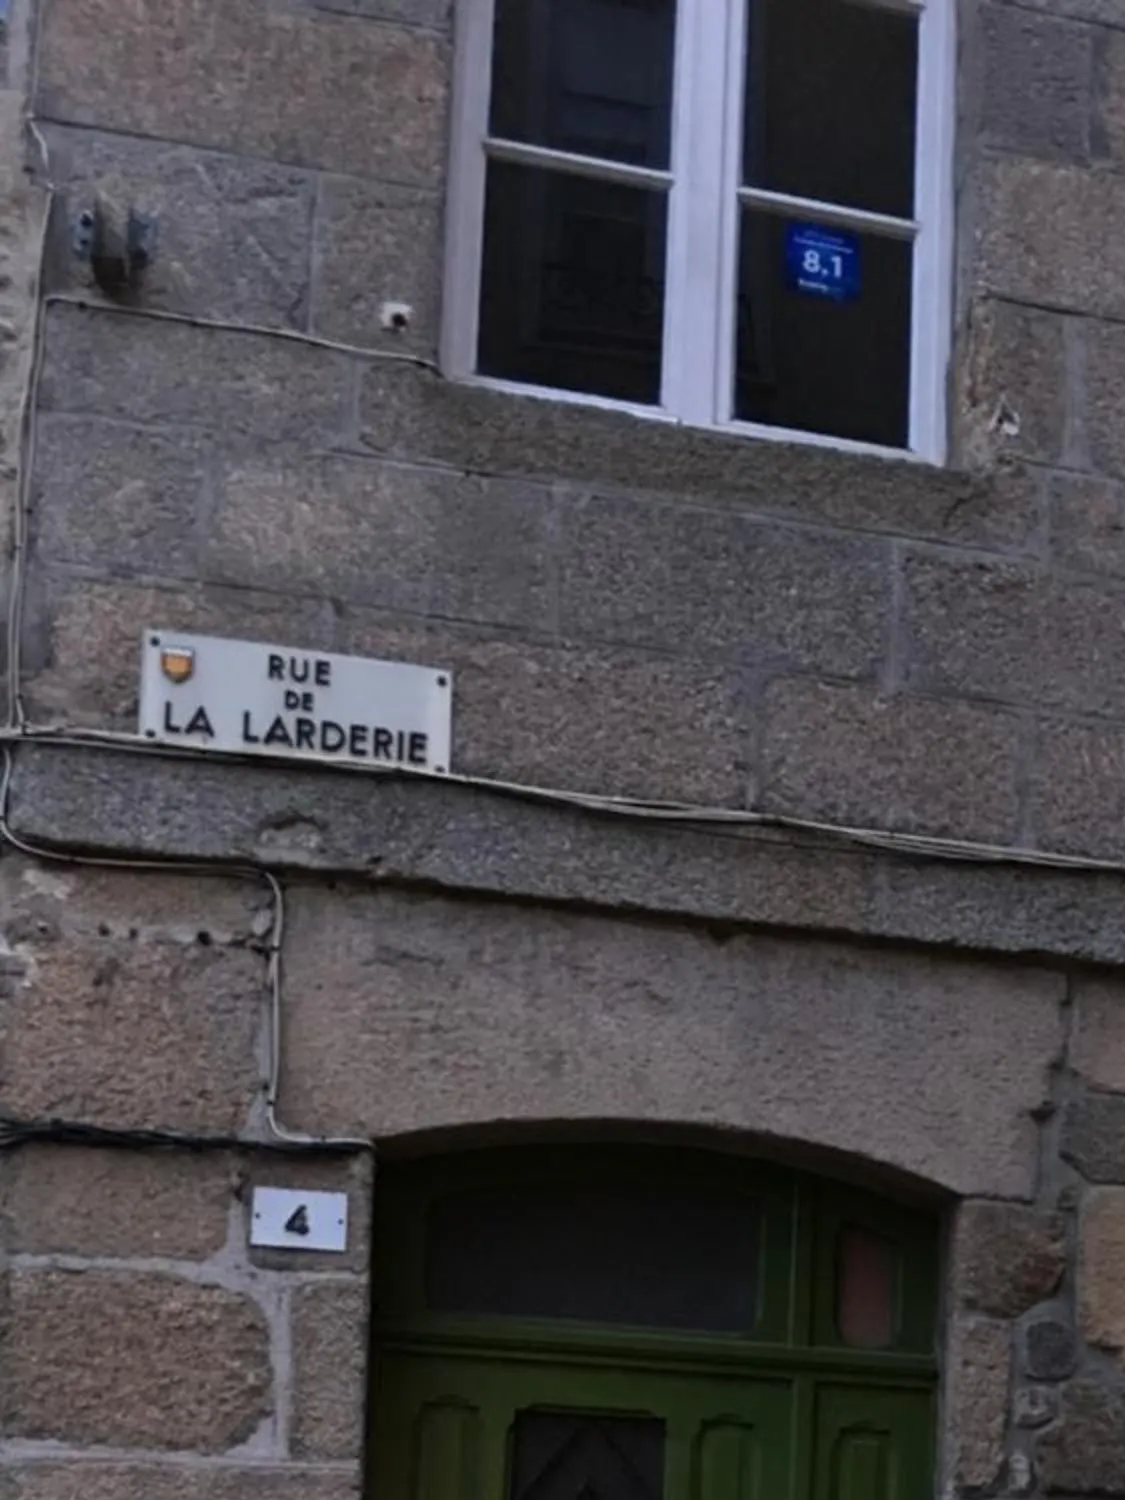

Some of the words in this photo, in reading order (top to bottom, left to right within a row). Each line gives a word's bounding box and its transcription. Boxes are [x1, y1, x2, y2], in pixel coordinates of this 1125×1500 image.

[268, 654, 331, 686] RUE
[284, 690, 314, 712] DE
[164, 701, 215, 738] LA
[242, 710, 428, 764] LARDERIE
[284, 1204, 310, 1236] 4
